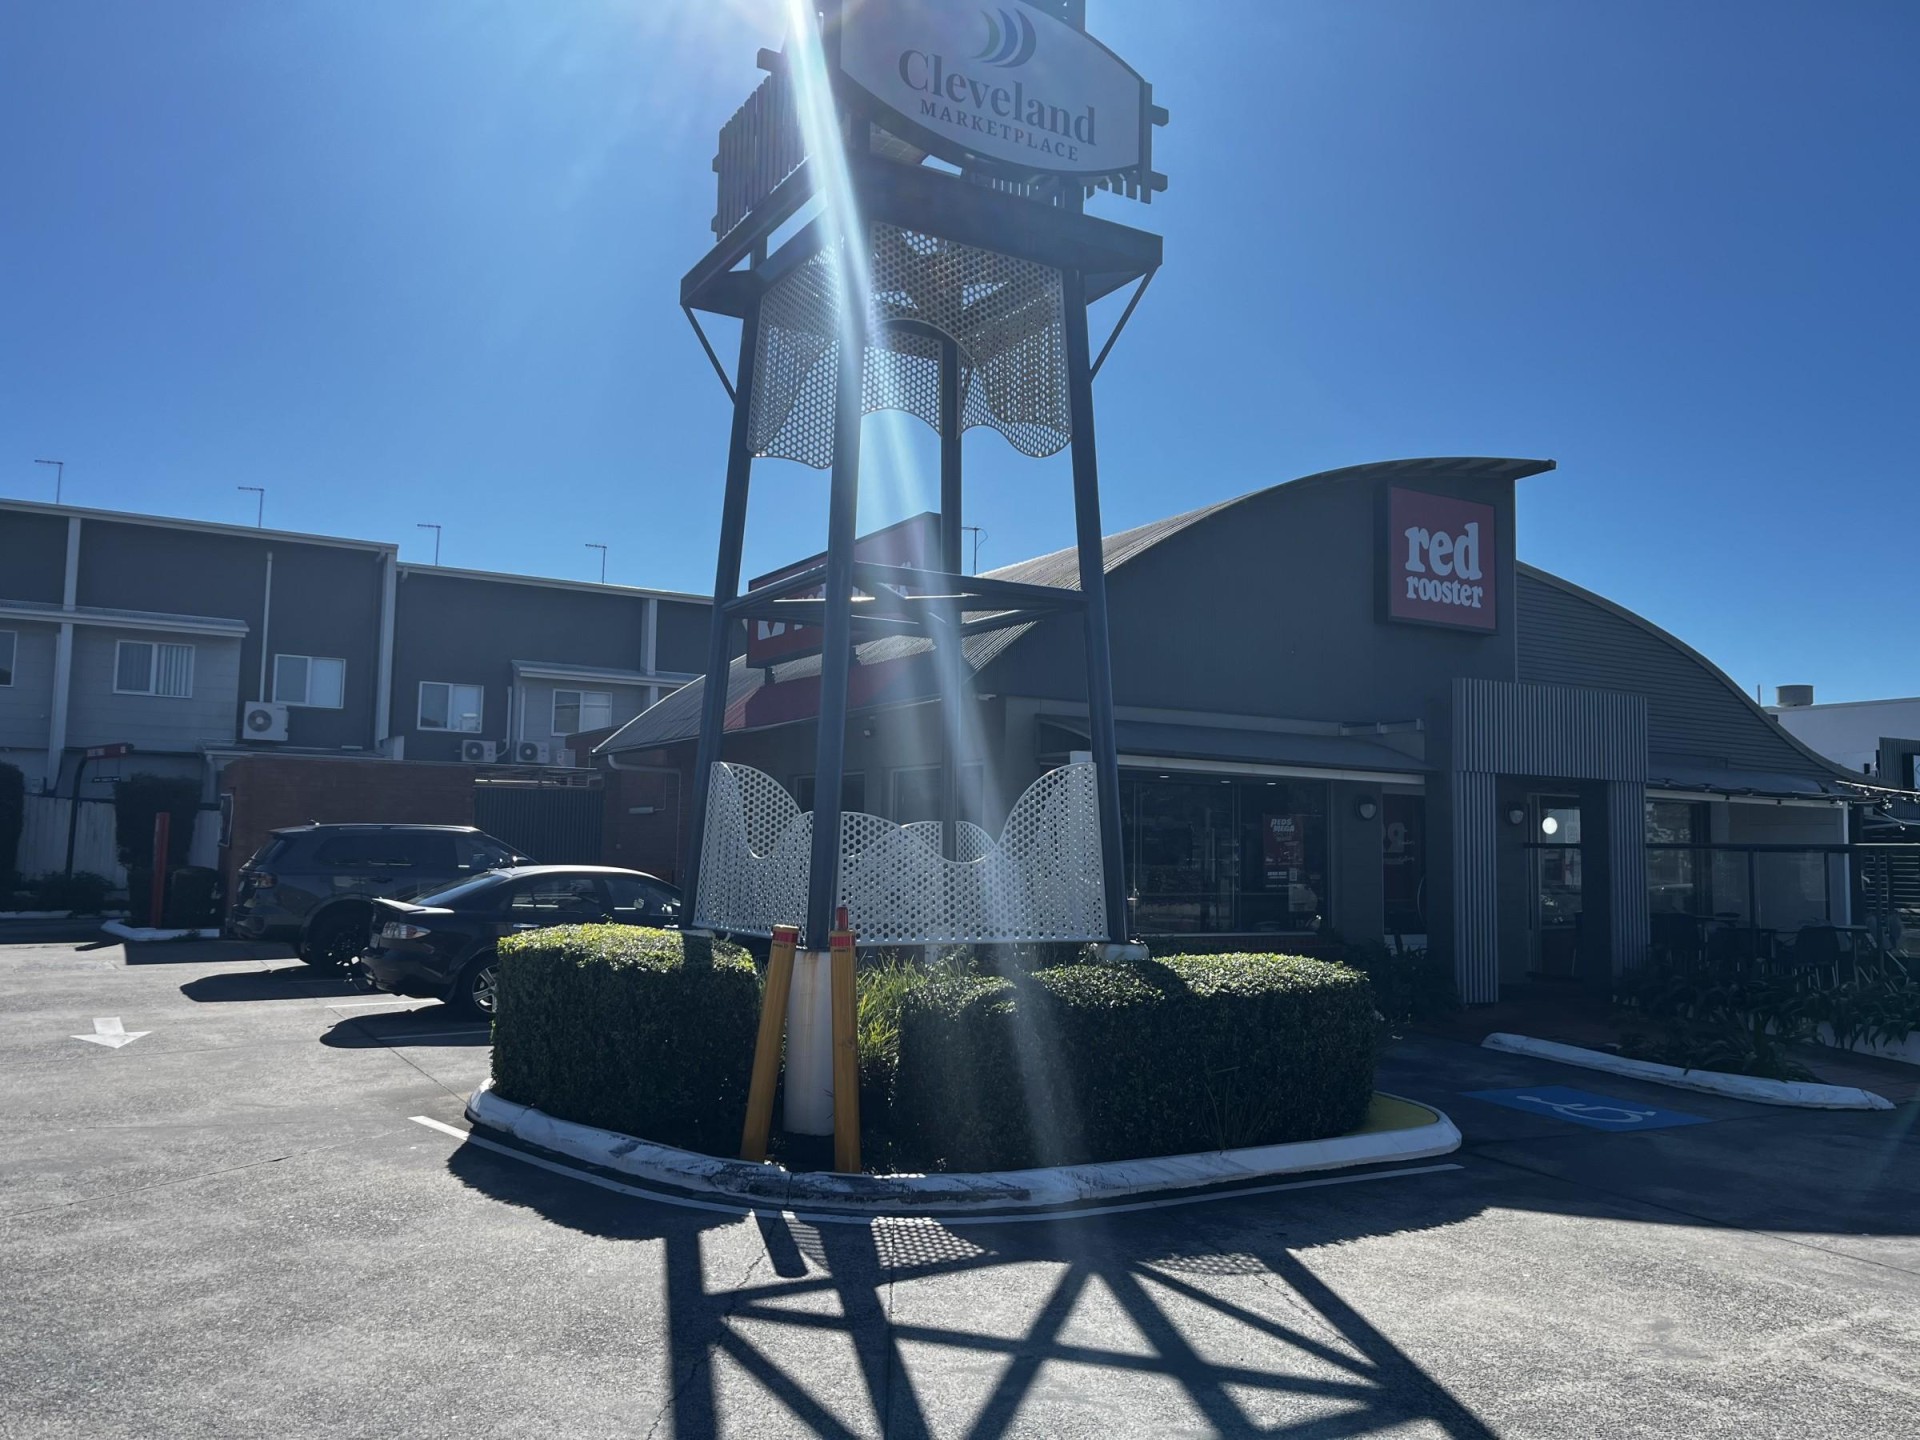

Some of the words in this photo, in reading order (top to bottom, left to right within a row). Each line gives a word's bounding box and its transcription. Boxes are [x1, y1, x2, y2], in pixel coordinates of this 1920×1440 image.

[899, 50, 1097, 146] Cleveland
[920, 99, 1078, 162] MARKETPLACE
[1405, 522, 1482, 580] red
[1406, 576, 1483, 608] rooster
